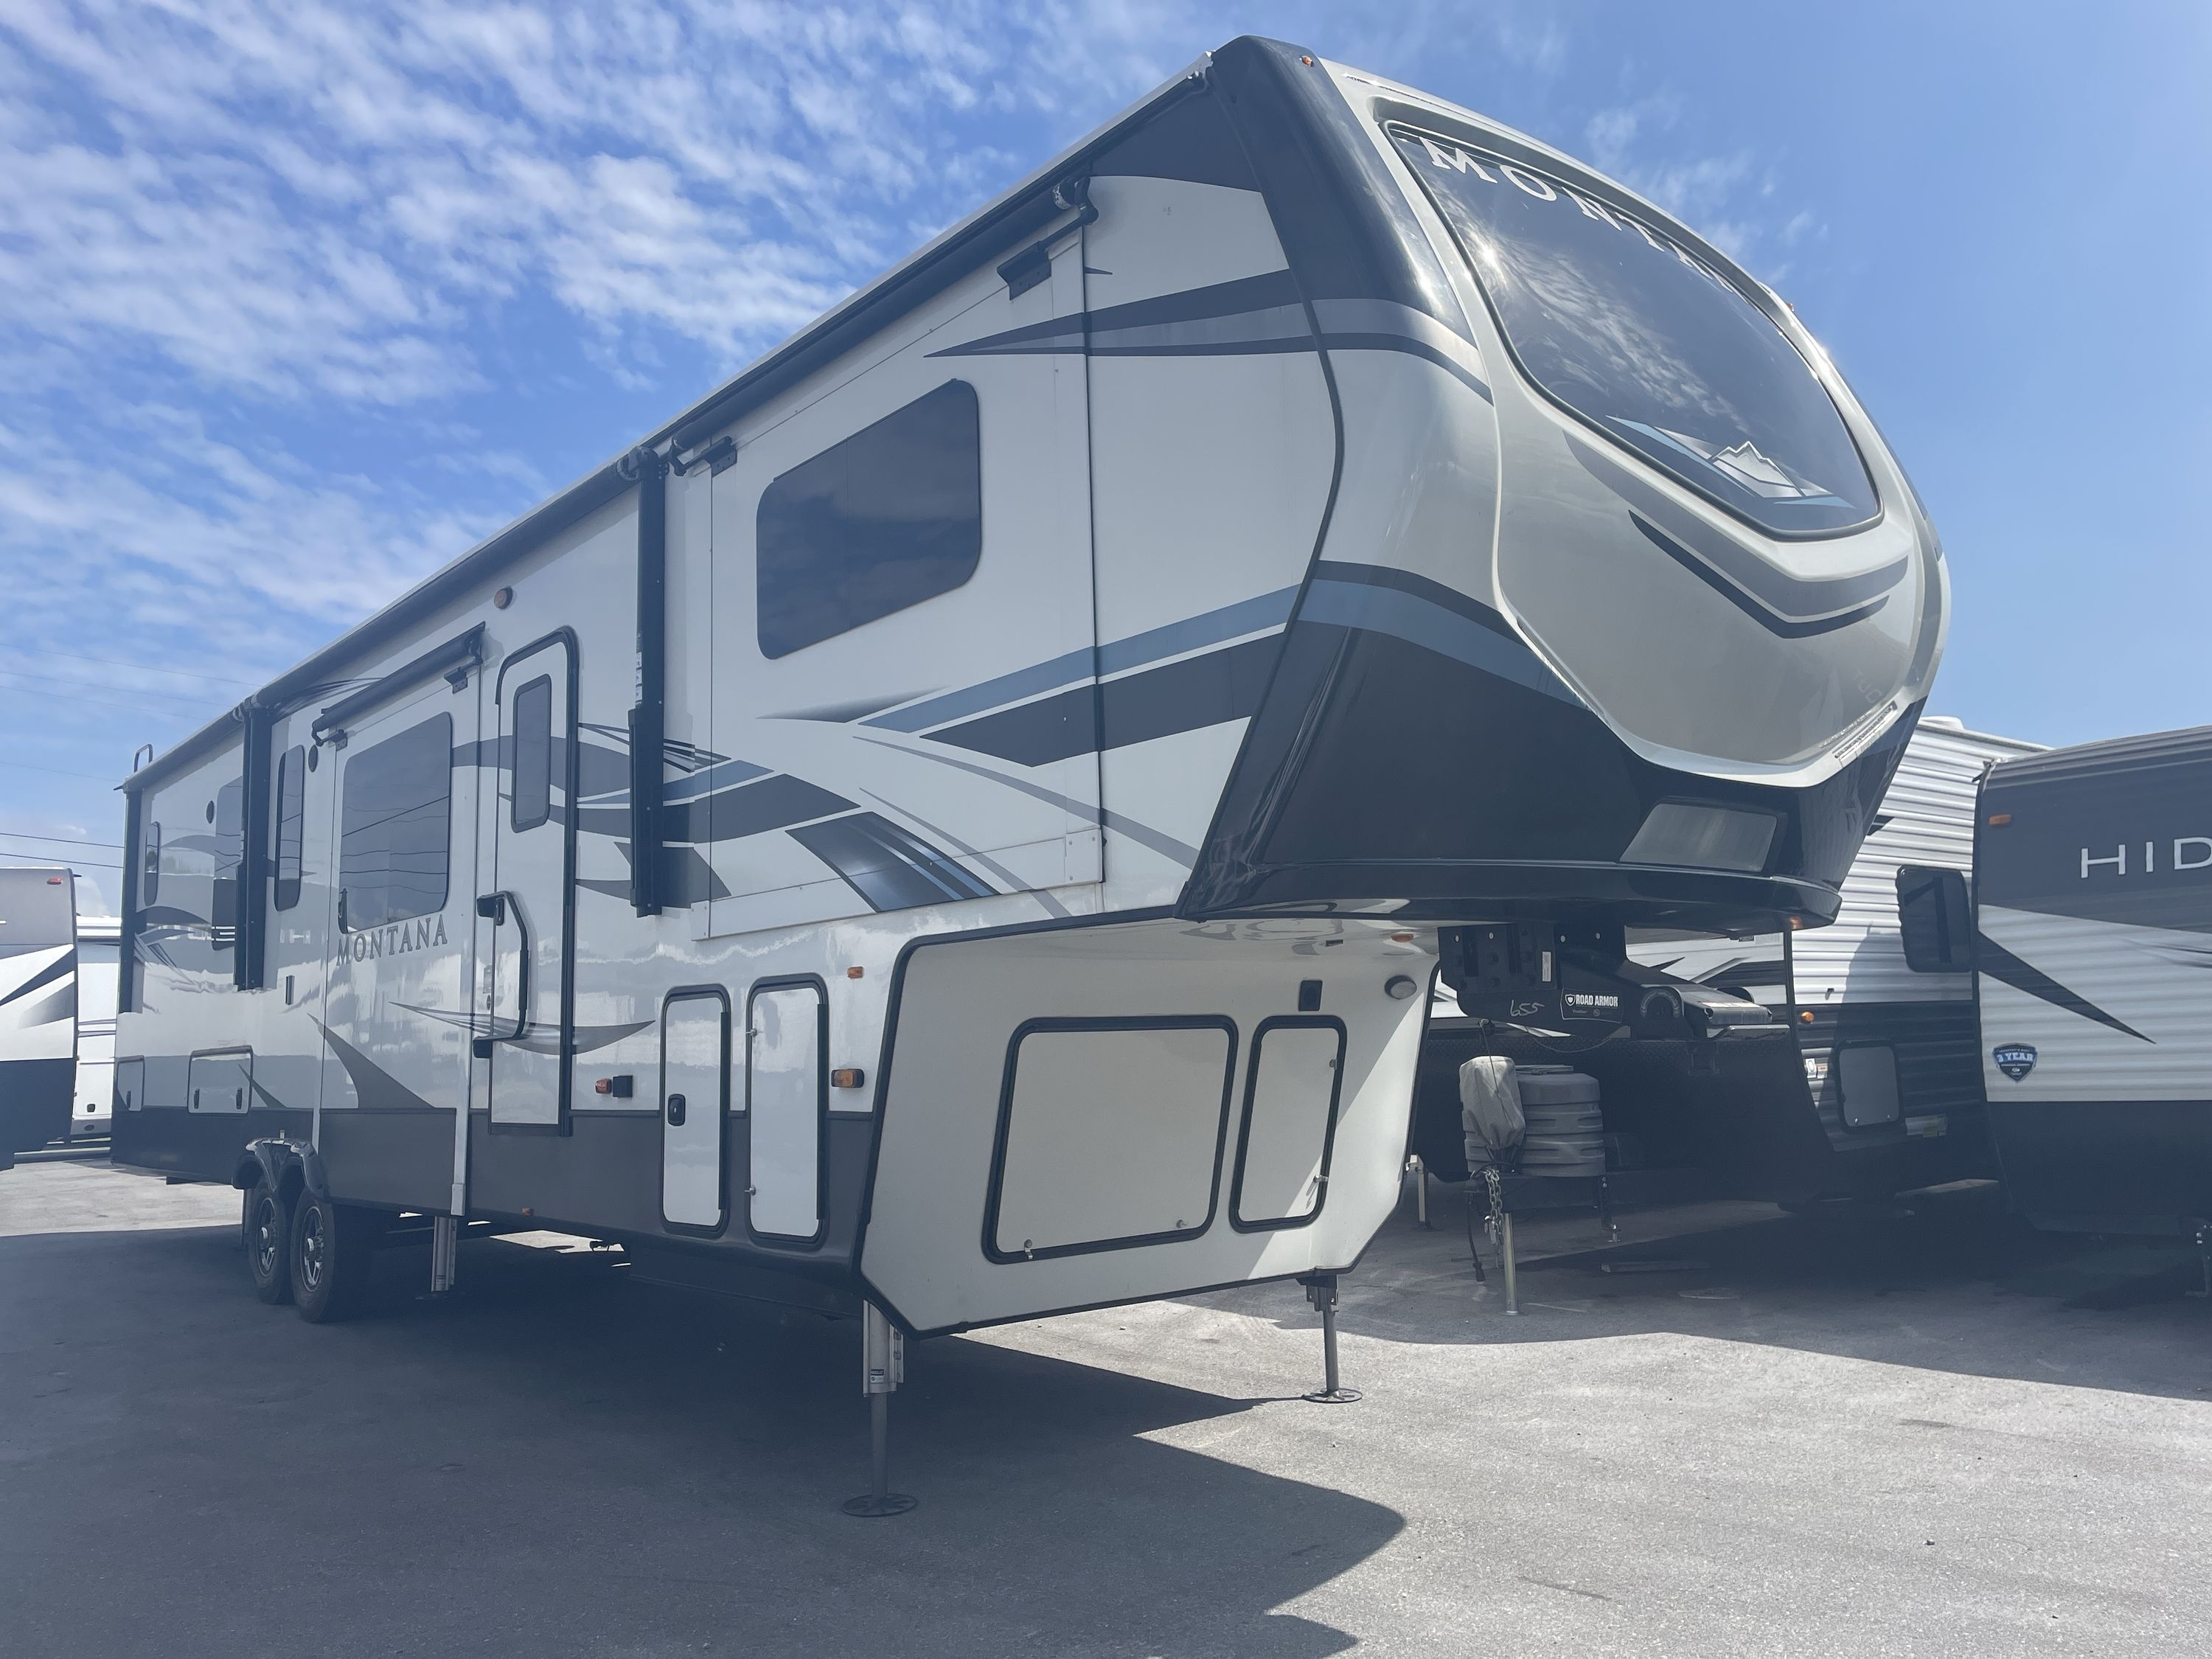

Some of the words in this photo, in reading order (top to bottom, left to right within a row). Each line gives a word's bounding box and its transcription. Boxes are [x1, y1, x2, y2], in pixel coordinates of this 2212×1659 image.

[2080, 836, 2212, 879] HID
[336, 914, 448, 966] MONTANA
[1576, 994, 1593, 1006] ROAD
[1594, 995, 1618, 1007] ARMOR
[2006, 1052, 2034, 1062] YEAR
